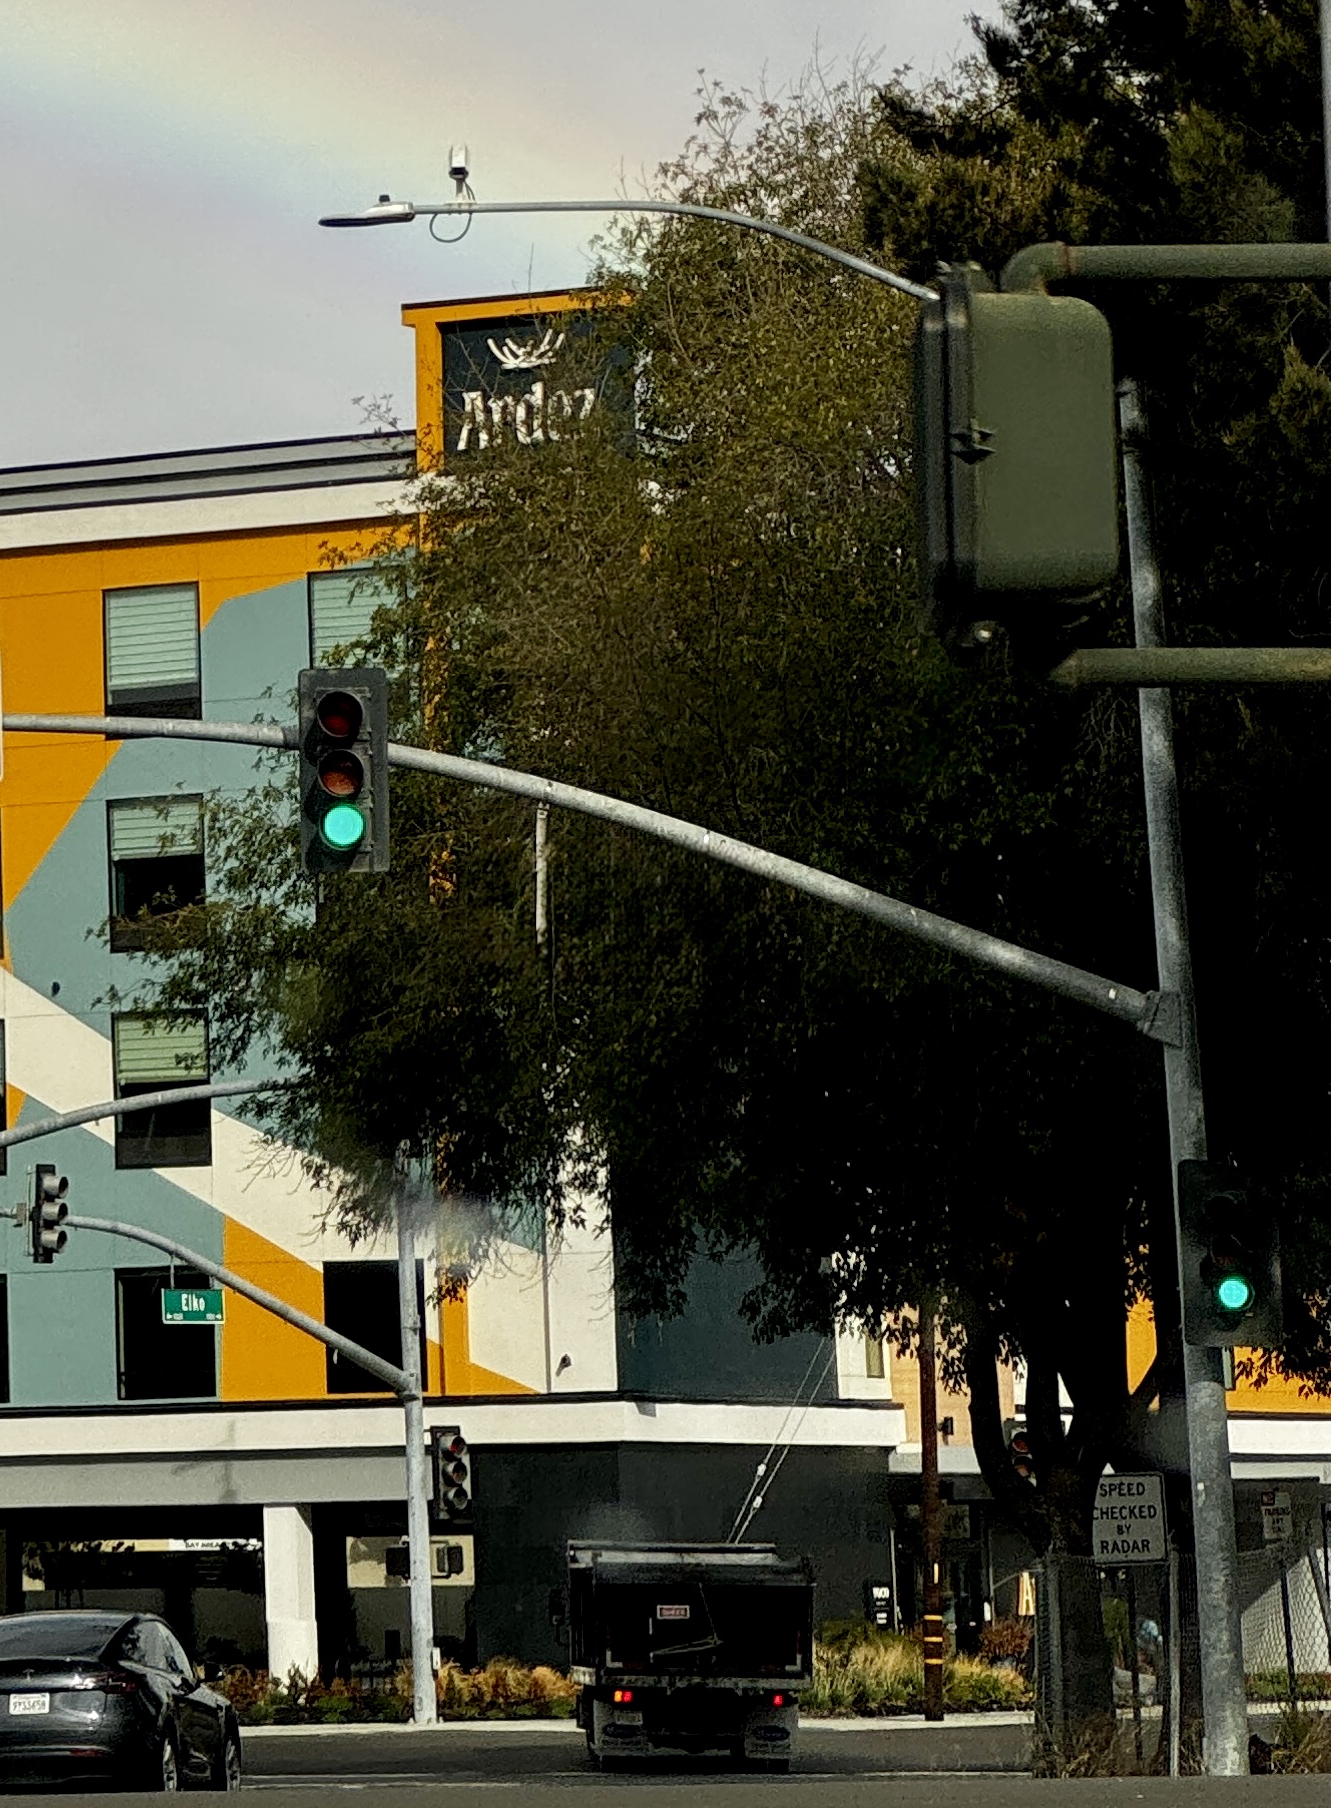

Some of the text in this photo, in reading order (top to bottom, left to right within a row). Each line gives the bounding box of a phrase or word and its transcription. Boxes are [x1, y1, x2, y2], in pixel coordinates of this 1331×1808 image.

[181, 1293, 206, 1312] Elko
[1099, 1482, 1146, 1498] SPEED
[1092, 1504, 1158, 1521] CHECKED
[1116, 1523, 1132, 1536] BY
[1100, 1538, 1152, 1555] RADAR
